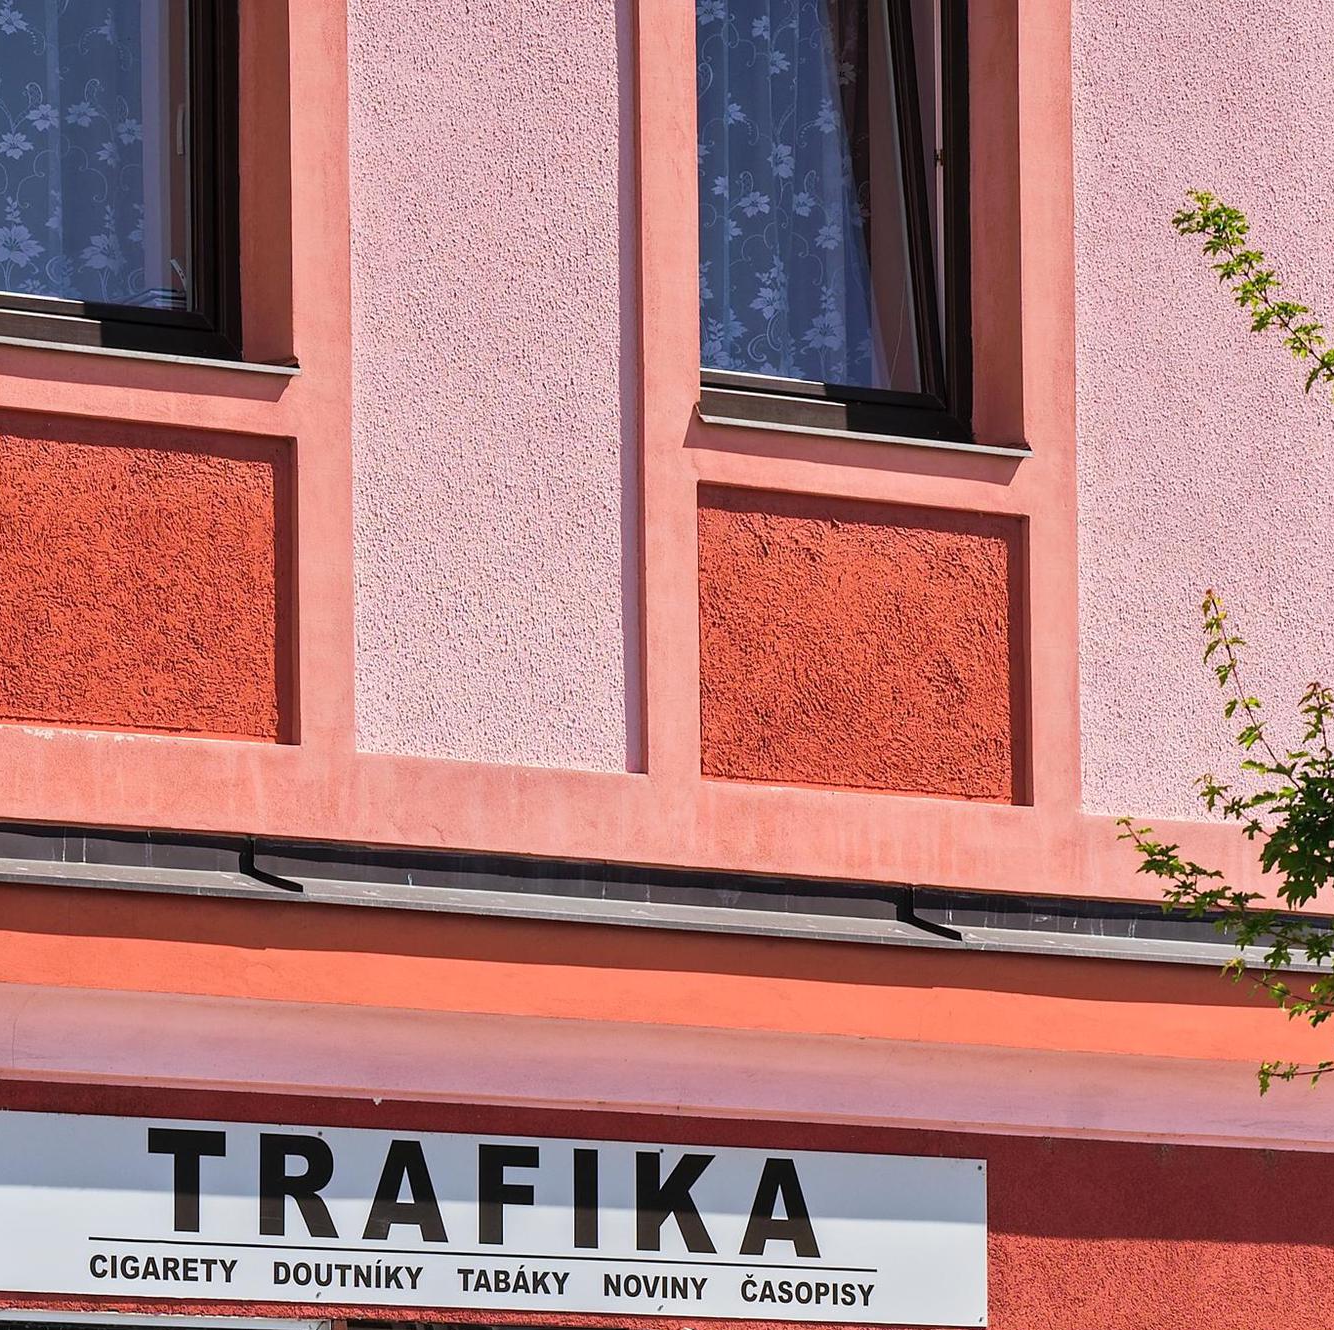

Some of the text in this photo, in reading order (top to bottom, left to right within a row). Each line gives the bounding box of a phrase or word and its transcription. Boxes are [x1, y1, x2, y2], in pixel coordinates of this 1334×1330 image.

[148, 1127, 821, 1259] TRAFIKA
[88, 1254, 875, 1308] CIGARETY DOUTNÍKY TABÁKY NOVINY ČASOPISY
